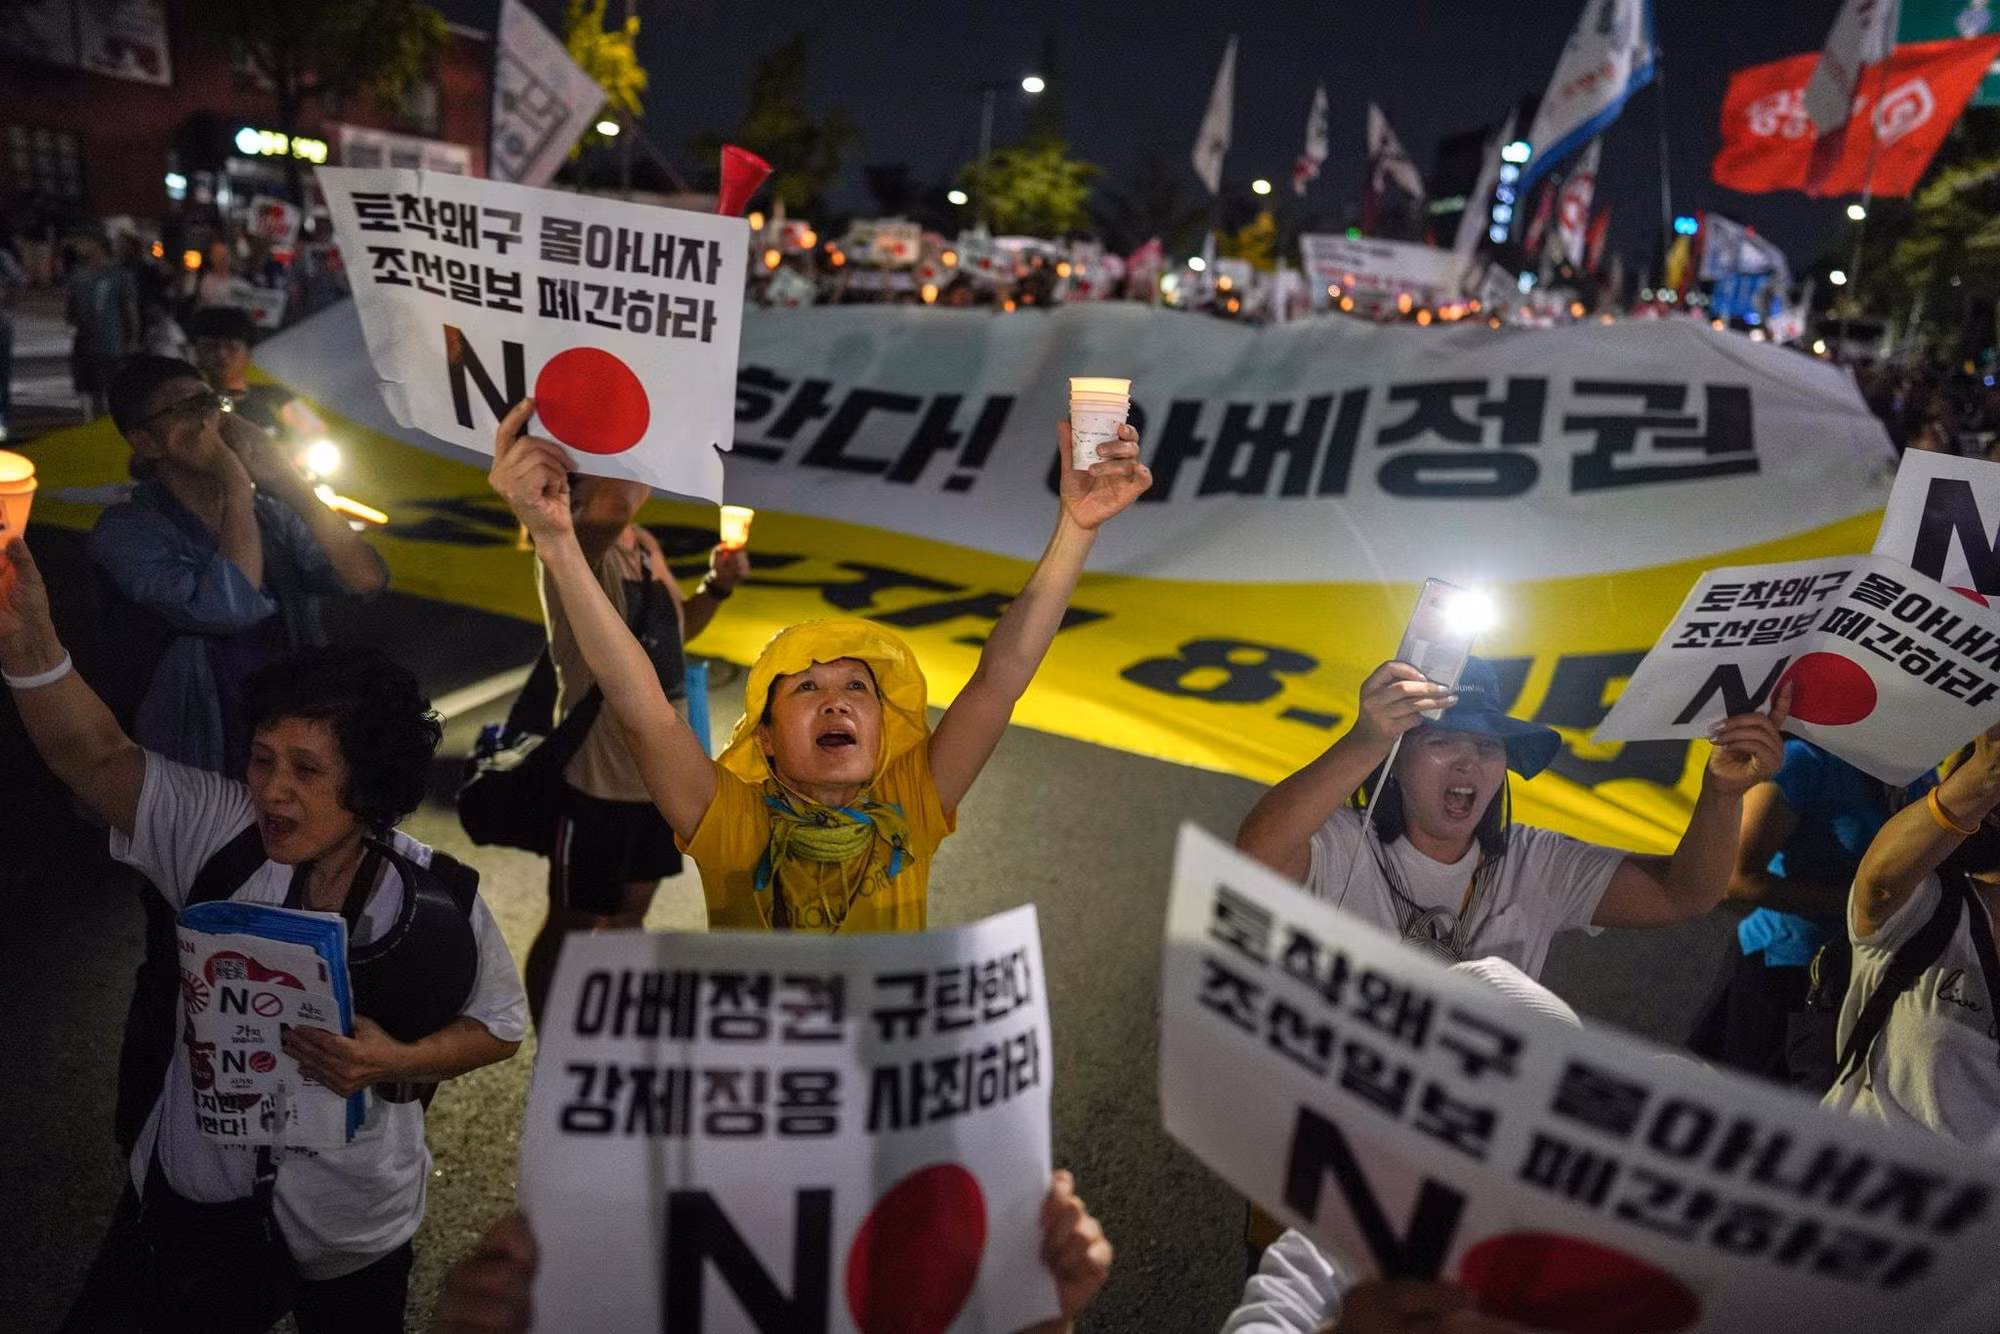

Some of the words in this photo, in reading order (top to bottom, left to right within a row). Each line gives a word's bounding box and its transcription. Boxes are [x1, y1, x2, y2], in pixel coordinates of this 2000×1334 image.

[351, 192, 523, 255] 토착왜구
[539, 215, 722, 284] 몰아내자
[367, 245, 523, 313] 조선일보
[537, 276, 717, 343] 폐간하라
[1671, 608, 1824, 649] 조선일보
[1695, 570, 1854, 613] 토착왜구
[573, 968, 847, 1044] 아베정권
[558, 1063, 839, 1138] 강제징용
[865, 1027, 1040, 1133] 사죄하라
[1198, 954, 1504, 1161] 조선일보
[1210, 882, 1531, 1081] 토착왜구
[1546, 1054, 1997, 1238] 몰아내자
